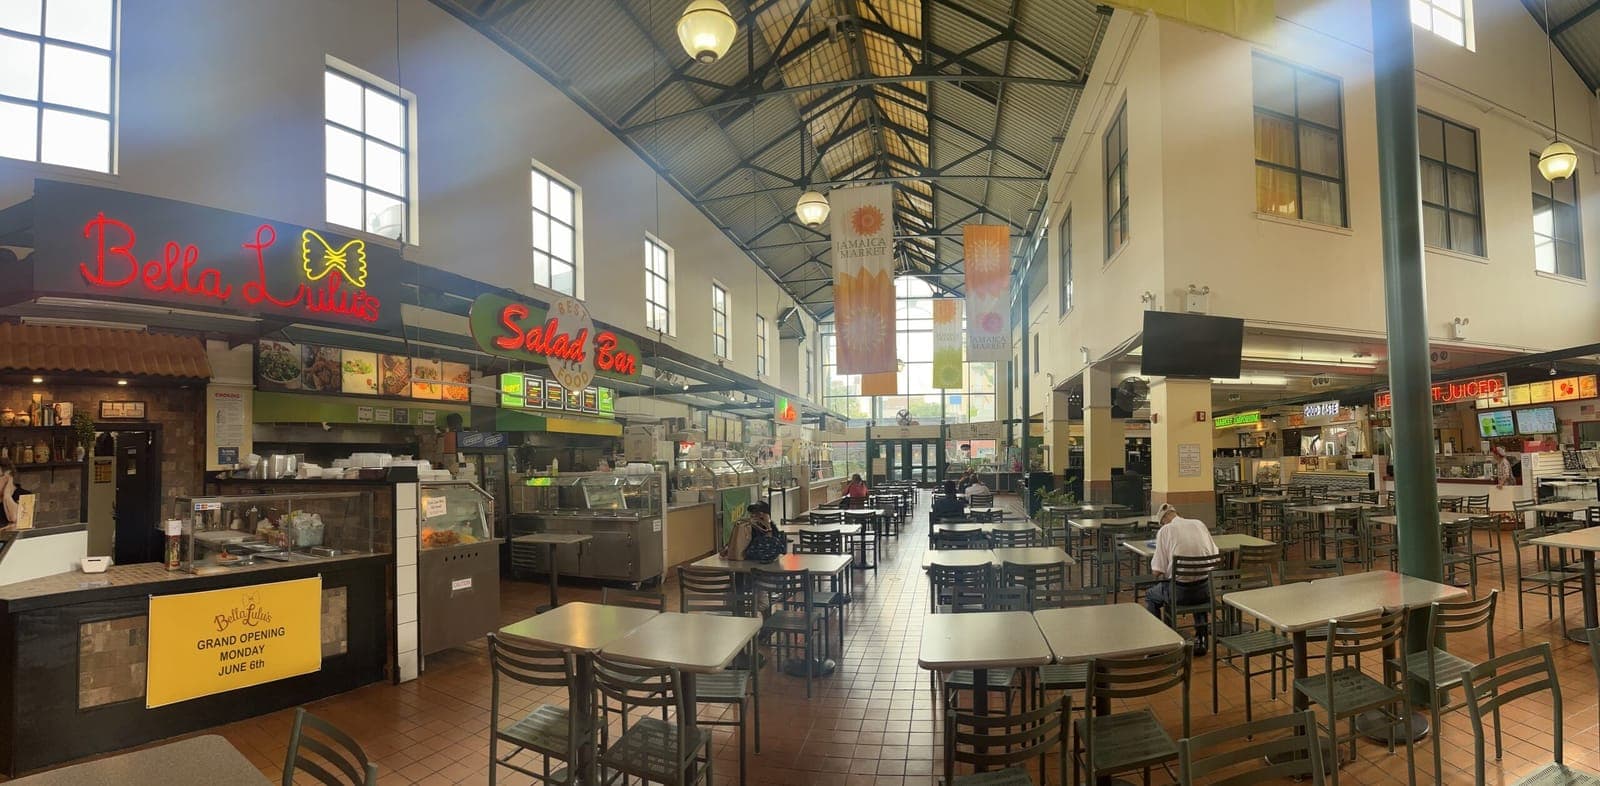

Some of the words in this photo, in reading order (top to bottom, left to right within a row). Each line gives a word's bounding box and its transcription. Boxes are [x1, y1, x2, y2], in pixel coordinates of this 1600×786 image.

[836, 237, 887, 249] JAMAICA
[839, 246, 887, 259] MARKET
[80, 211, 232, 300] Bella
[242, 224, 381, 322] Lulu's
[558, 301, 587, 321] BEST
[497, 303, 589, 364] Salad
[593, 331, 636, 376] Bar
[557, 367, 589, 387] FOOD
[1442, 378, 1501, 402] JUICED
[197, 634, 237, 650] GRAND
[239, 626, 286, 643] OPENING
[219, 645, 265, 662] MONDAY
[218, 661, 247, 677] JUNE
[249, 659, 265, 671] 6th
